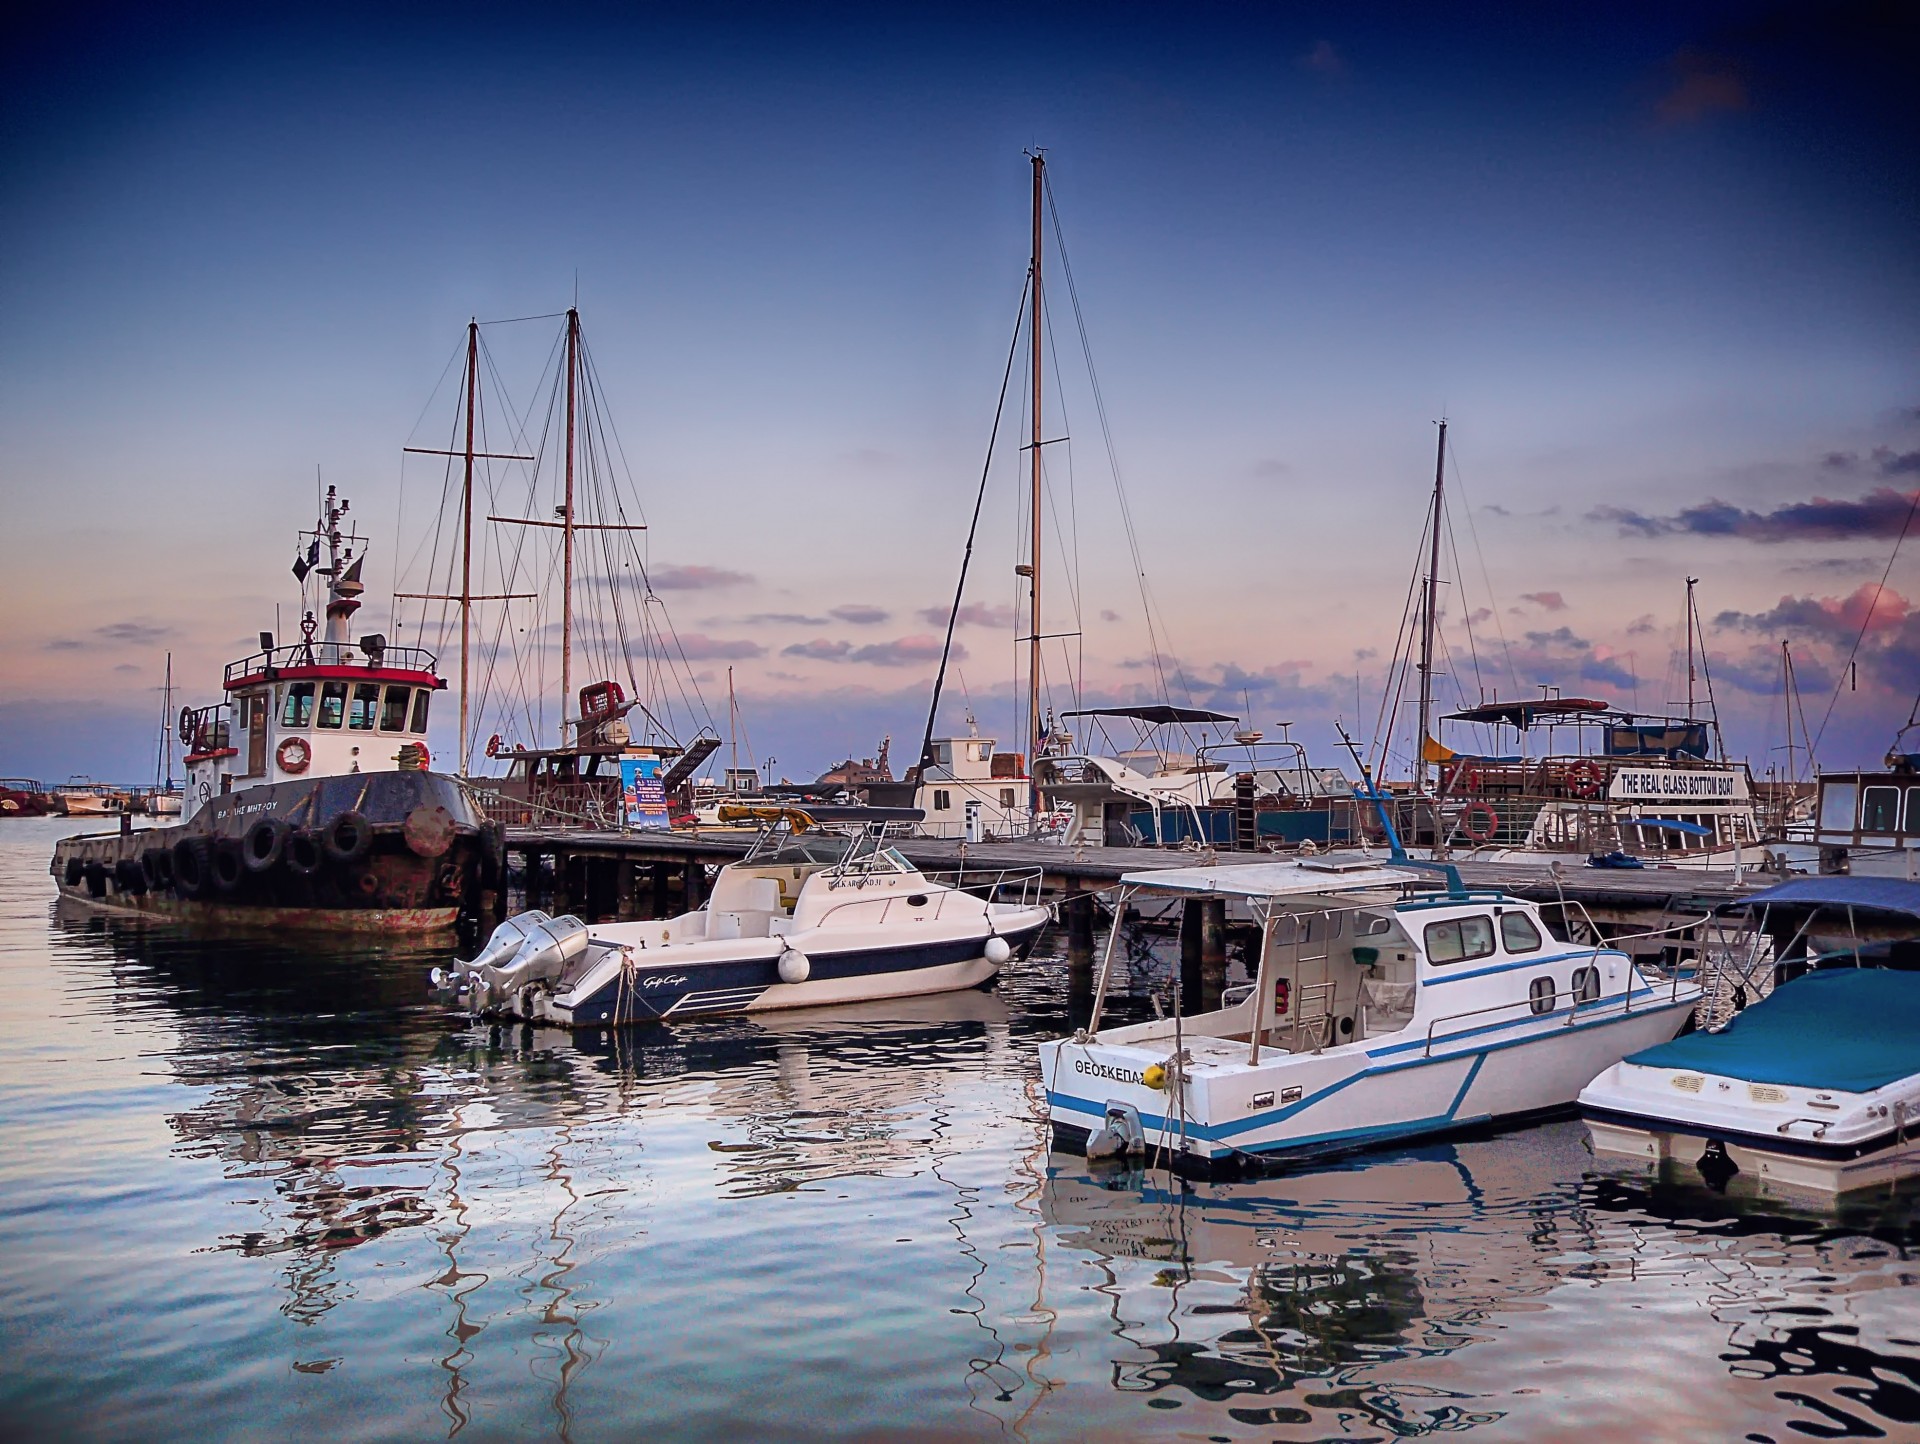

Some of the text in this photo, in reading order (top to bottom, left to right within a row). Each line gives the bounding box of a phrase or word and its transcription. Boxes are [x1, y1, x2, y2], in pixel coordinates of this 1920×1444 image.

[1621, 773, 1734, 796] THE REAL GLASS BOTTOM BOAT
[847, 879, 874, 888] AROND
